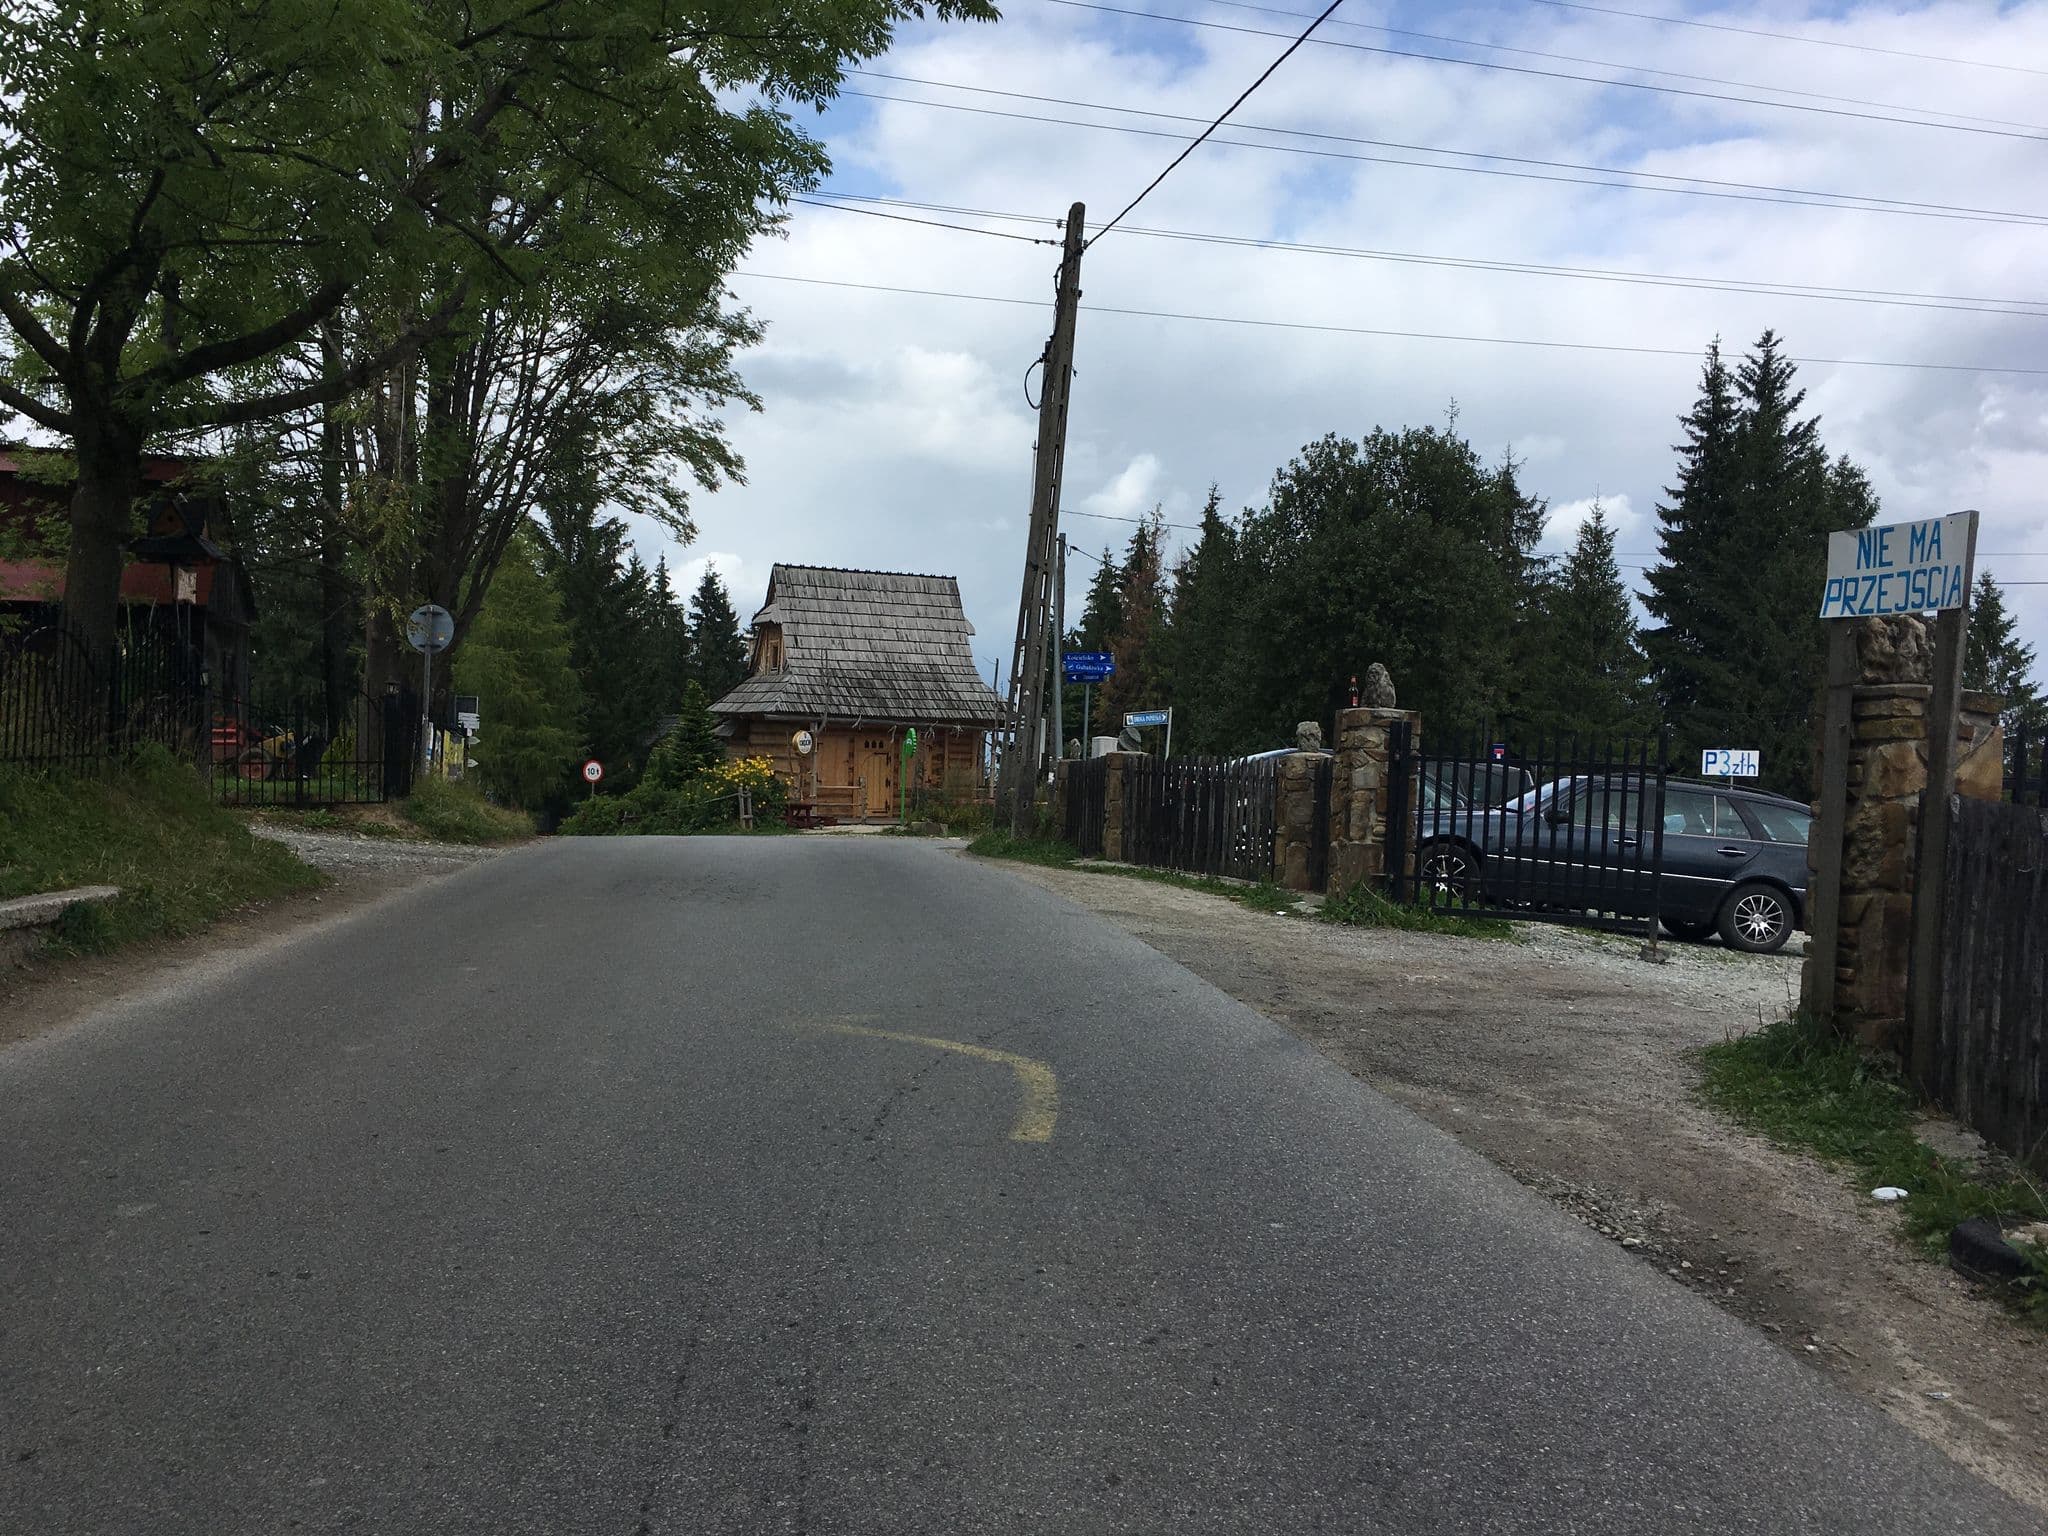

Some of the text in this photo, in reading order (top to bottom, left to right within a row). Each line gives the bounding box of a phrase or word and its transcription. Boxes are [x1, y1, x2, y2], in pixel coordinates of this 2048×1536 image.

[1856, 520, 1942, 570] NIE MA
[1821, 564, 1963, 616] PRZEJŚCIA
[587, 767, 595, 776] 10
